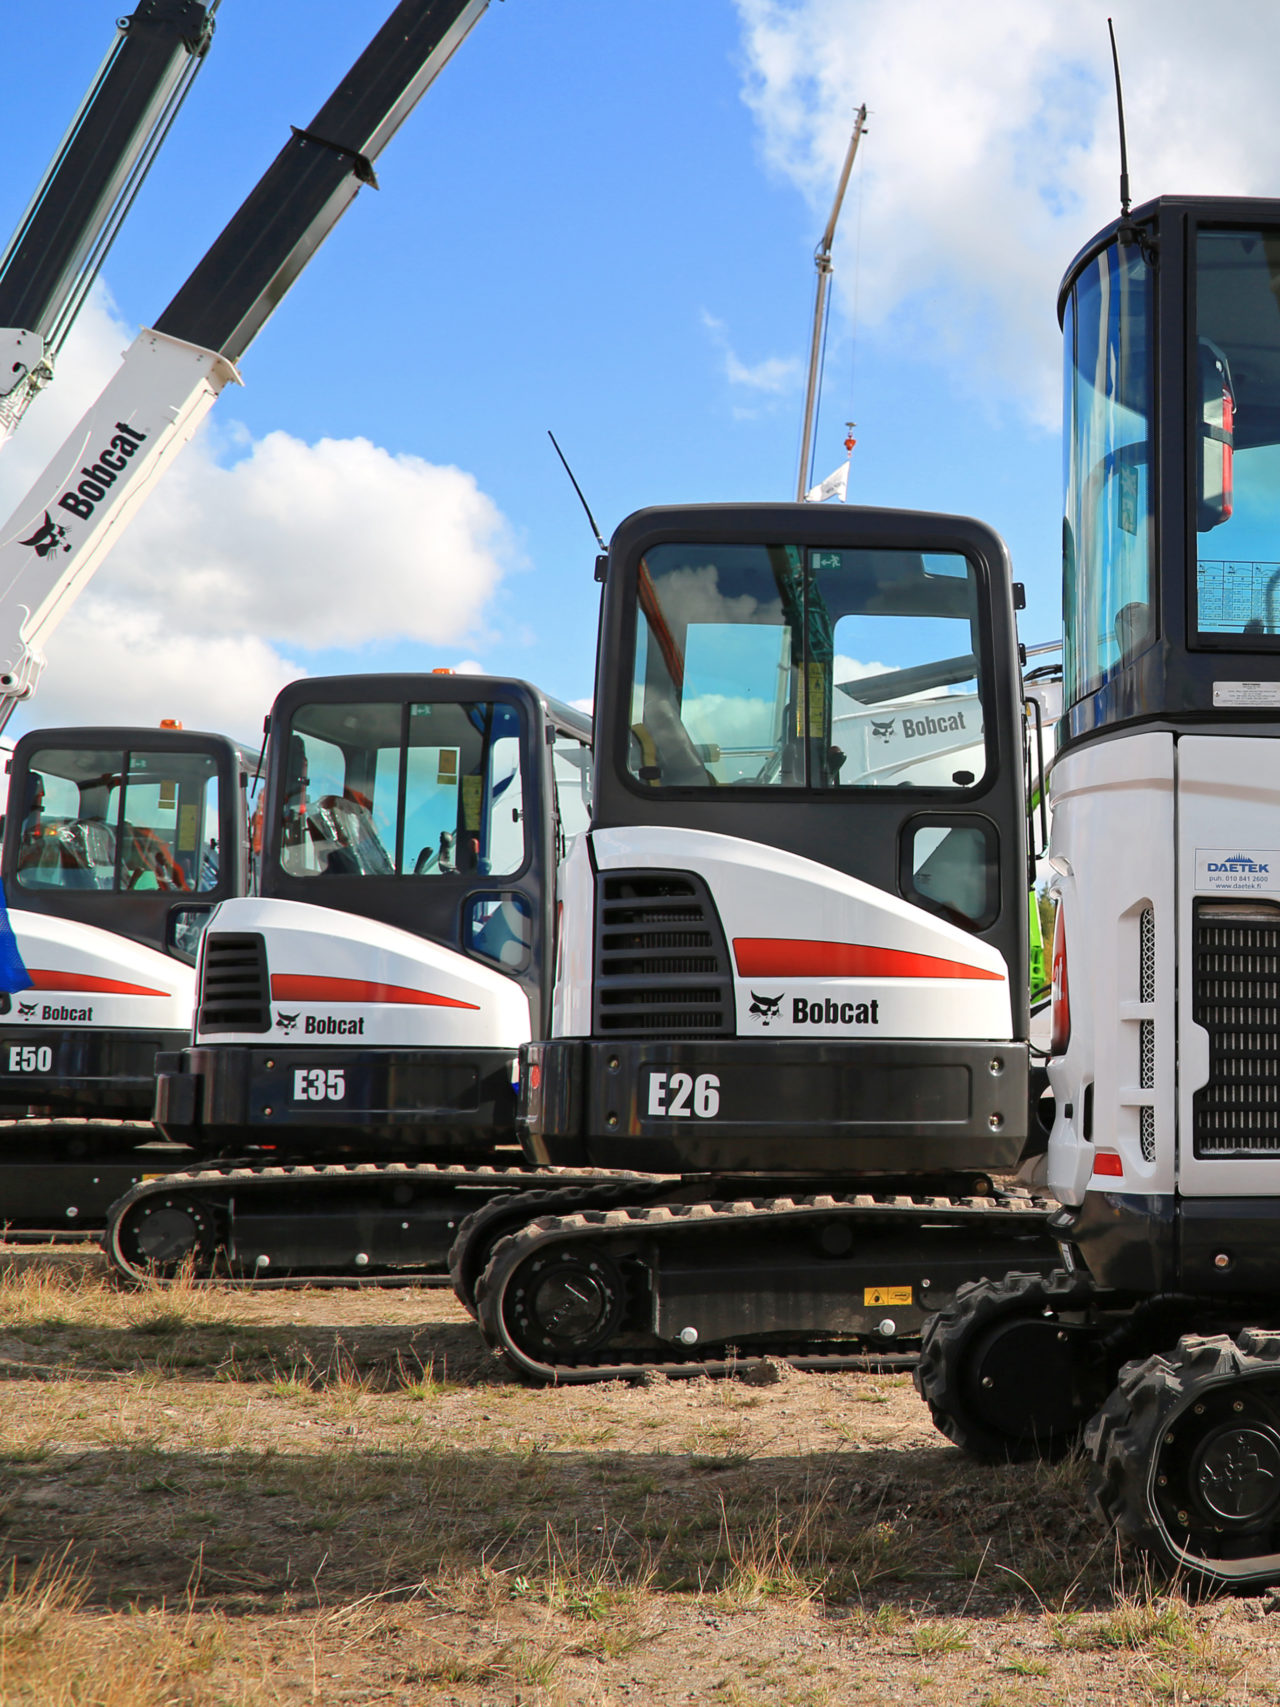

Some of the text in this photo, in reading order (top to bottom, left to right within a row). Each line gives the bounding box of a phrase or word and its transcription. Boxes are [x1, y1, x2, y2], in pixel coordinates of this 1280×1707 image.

[58, 422, 147, 521] Bobcat
[903, 711, 966, 738] Bobcat
[1207, 863, 1269, 873] DAETEK
[42, 1005, 93, 1021] Bobcat
[793, 998, 879, 1024] Bobcat
[305, 1016, 364, 1035] Bobcat
[9, 1046, 52, 1072] E50
[294, 1069, 346, 1101] E35
[648, 1072, 720, 1118] E26
